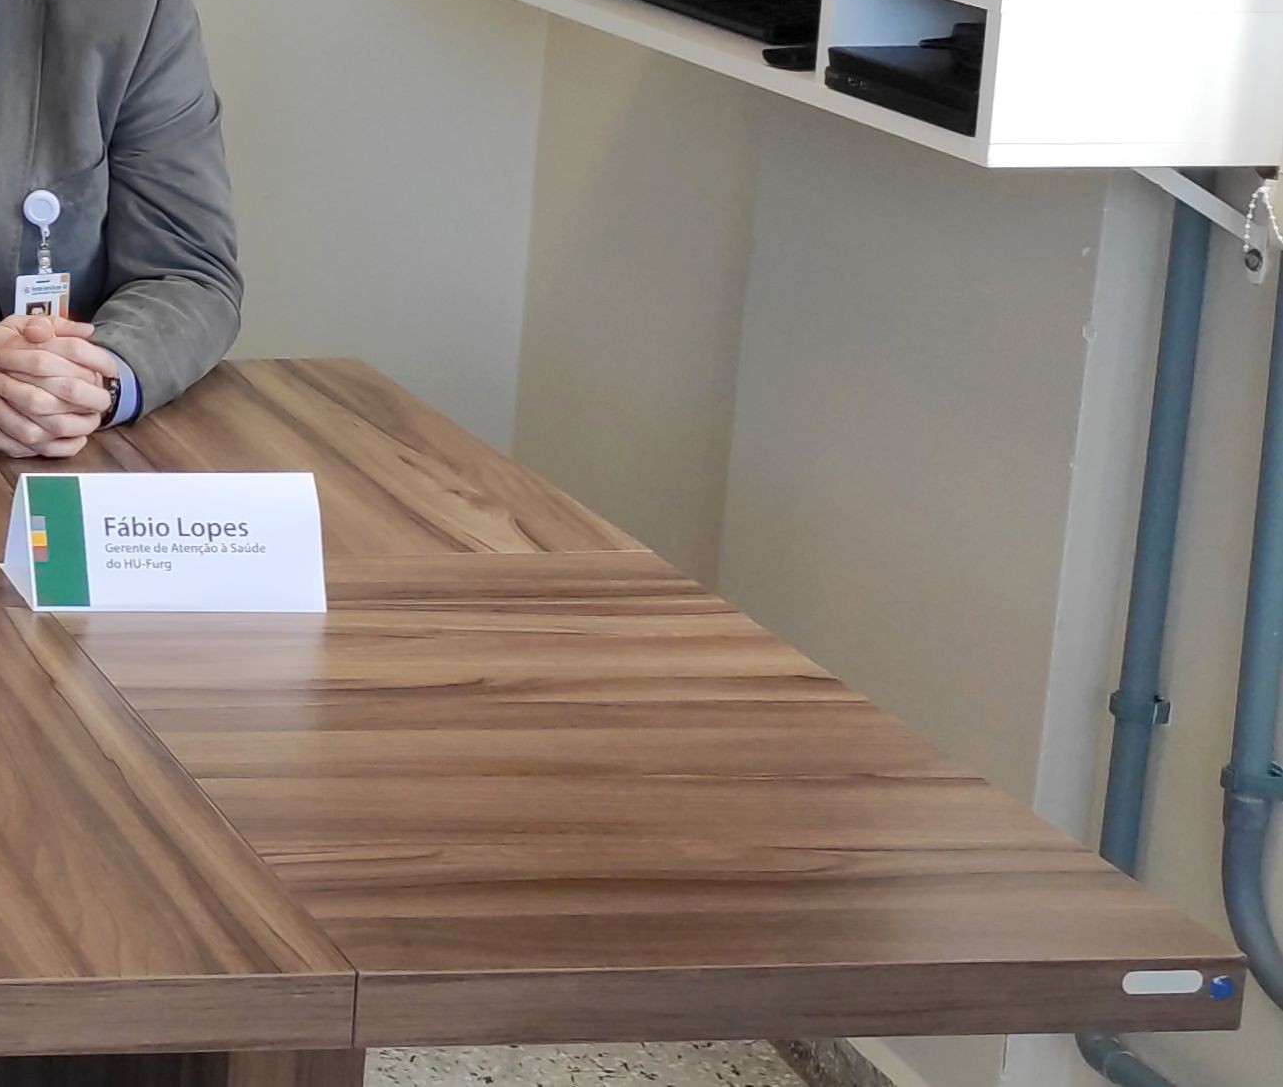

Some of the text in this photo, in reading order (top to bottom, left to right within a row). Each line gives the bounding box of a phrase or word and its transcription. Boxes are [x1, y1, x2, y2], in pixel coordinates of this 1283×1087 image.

[104, 516, 249, 543] Fábio Lopes
[105, 542, 266, 555] Gerente de Atenção à Saúde
[106, 558, 172, 572] do HU-Furg
